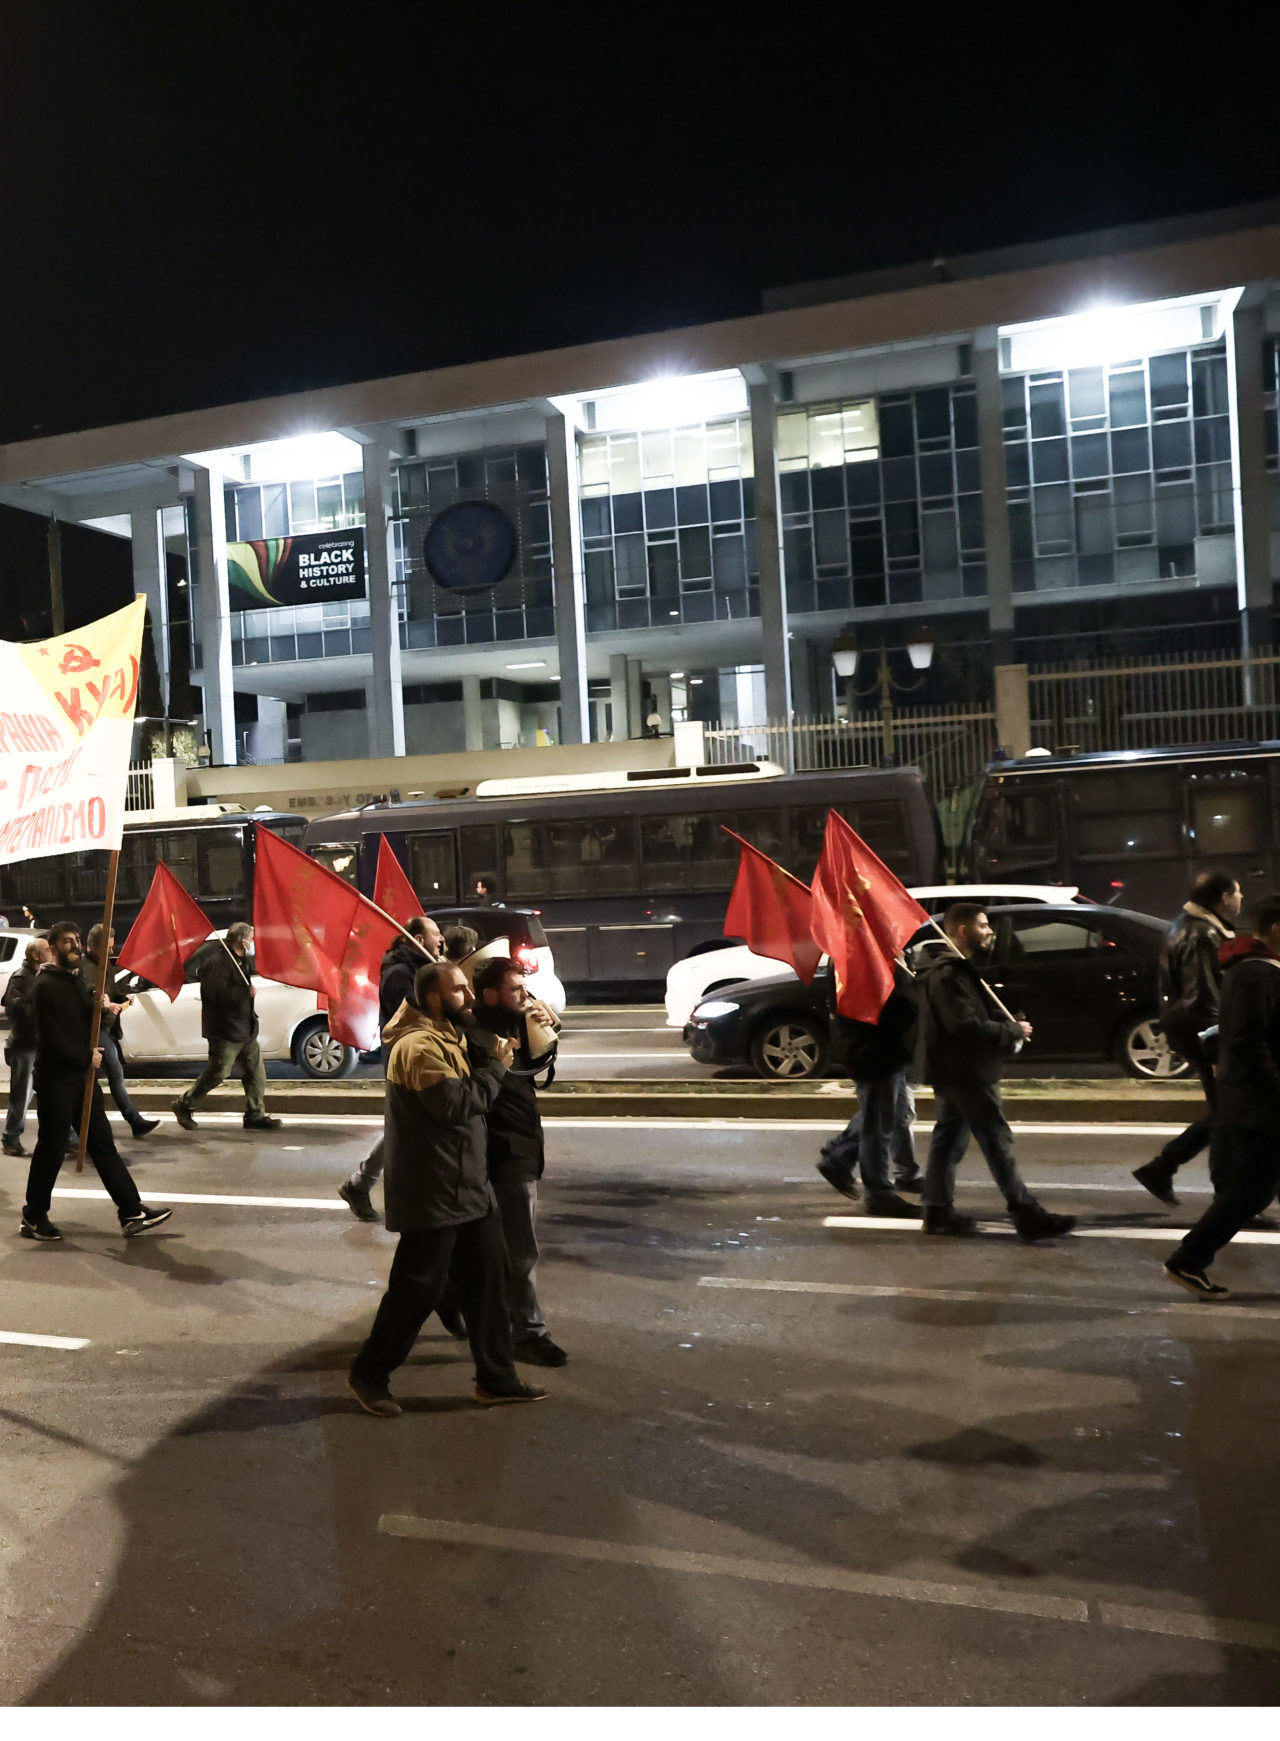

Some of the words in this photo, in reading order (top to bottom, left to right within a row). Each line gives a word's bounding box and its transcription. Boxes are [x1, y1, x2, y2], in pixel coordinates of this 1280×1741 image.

[318, 540, 355, 549] celebrating
[298, 548, 355, 567] BLACK
[299, 563, 355, 578] HISTORY
[300, 580, 308, 588] &
[309, 575, 356, 587] CULTURE
